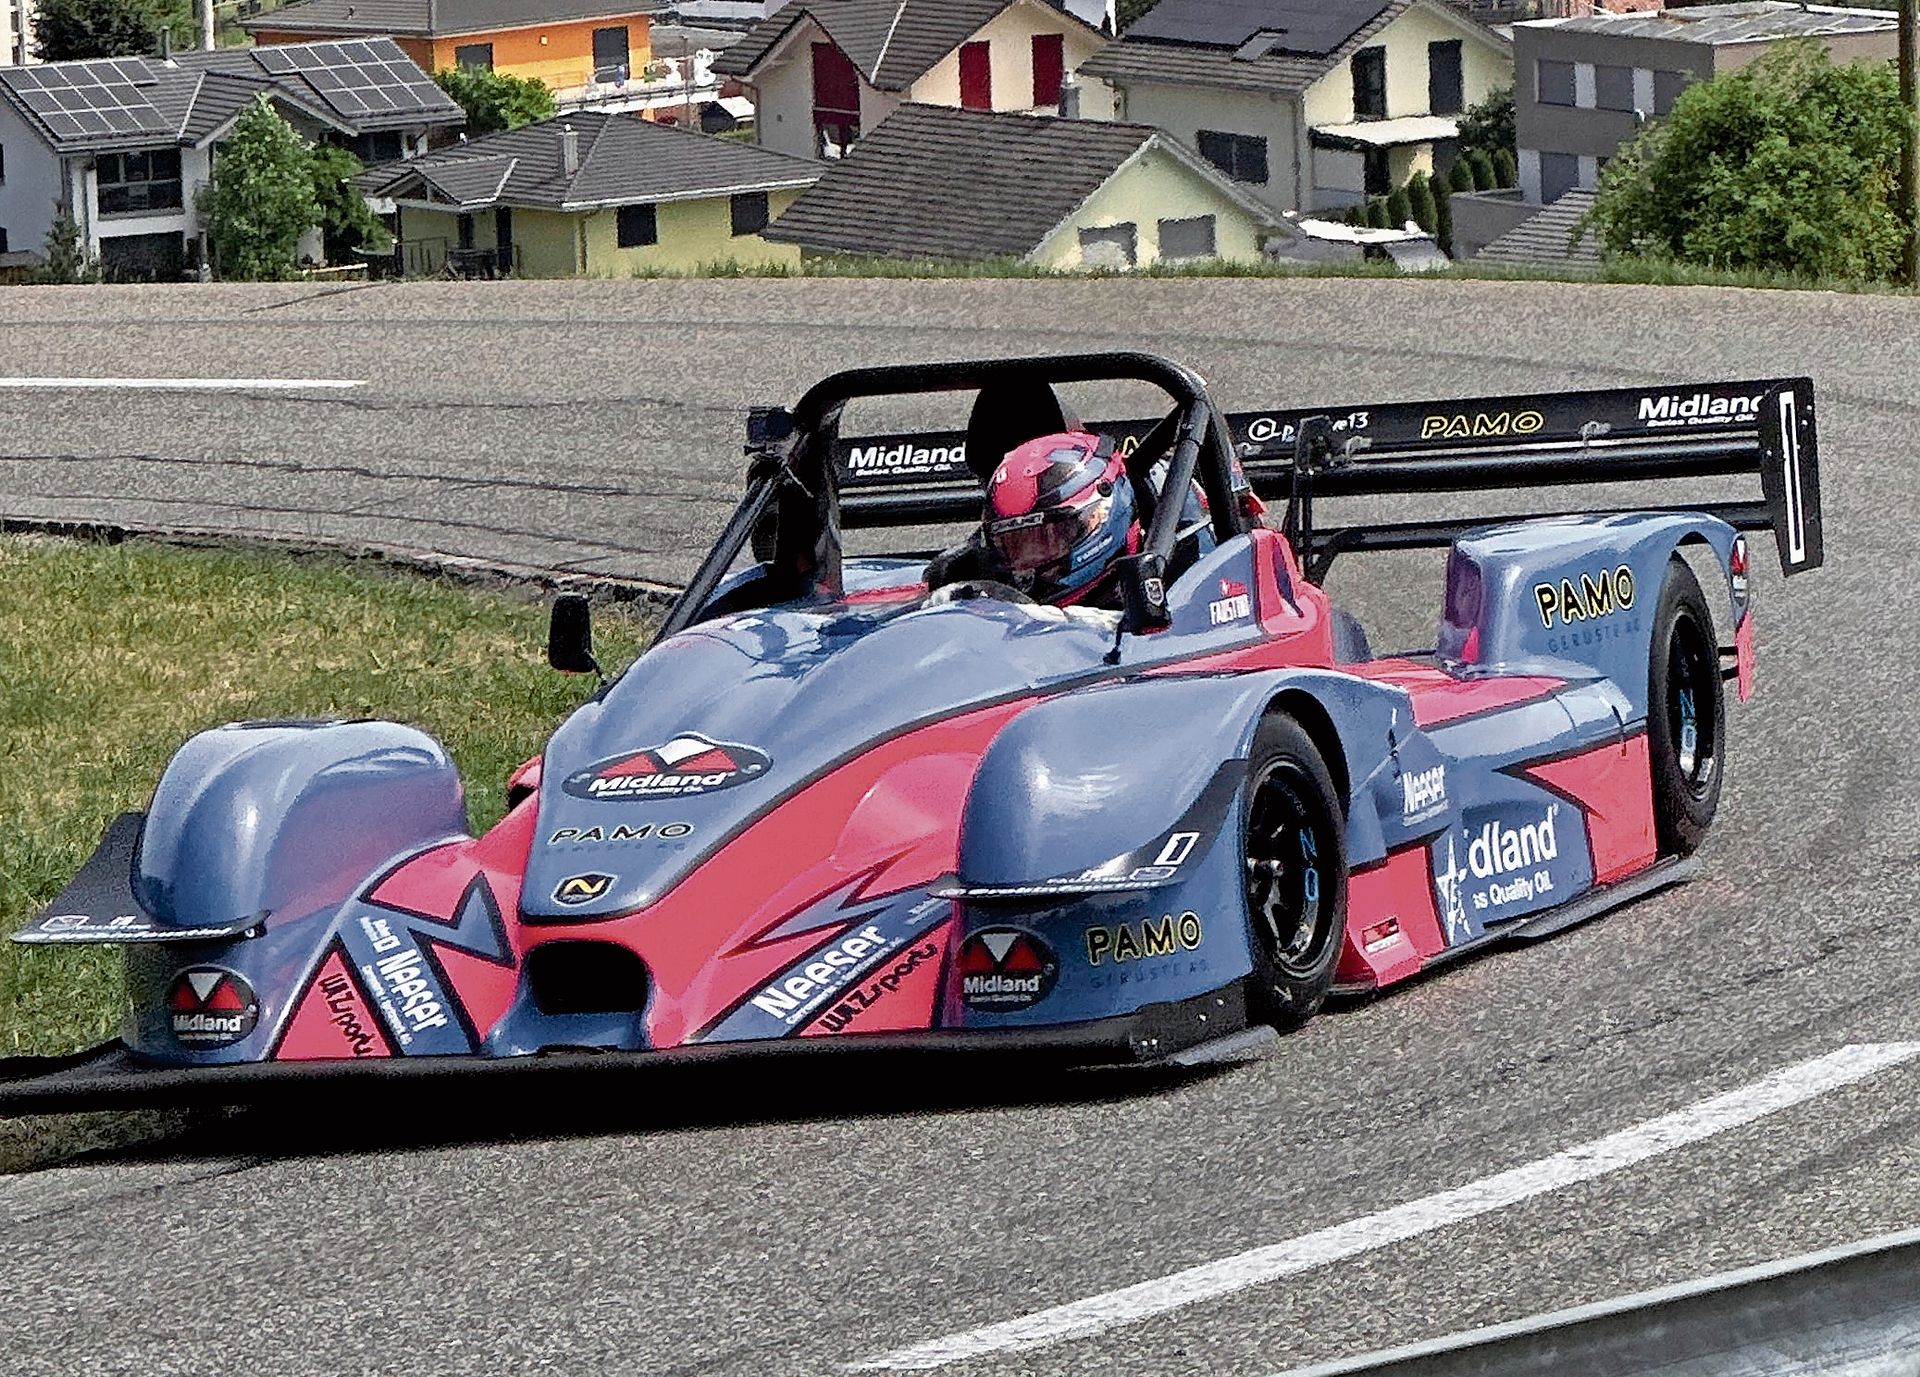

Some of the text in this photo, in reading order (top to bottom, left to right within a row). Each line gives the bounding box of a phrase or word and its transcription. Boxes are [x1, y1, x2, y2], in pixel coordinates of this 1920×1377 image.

[1420, 410, 1545, 440] PAMO
[848, 441, 966, 469] Midland
[1533, 563, 1635, 629] PAMO
[587, 771, 727, 792] Midland
[1402, 763, 1445, 814] Neeser
[546, 821, 695, 847] PAMO
[1084, 909, 1203, 967] PAMO
[376, 949, 448, 1032] Neeser
[751, 924, 888, 1020] Neeser
[963, 974, 1040, 994] Midland
